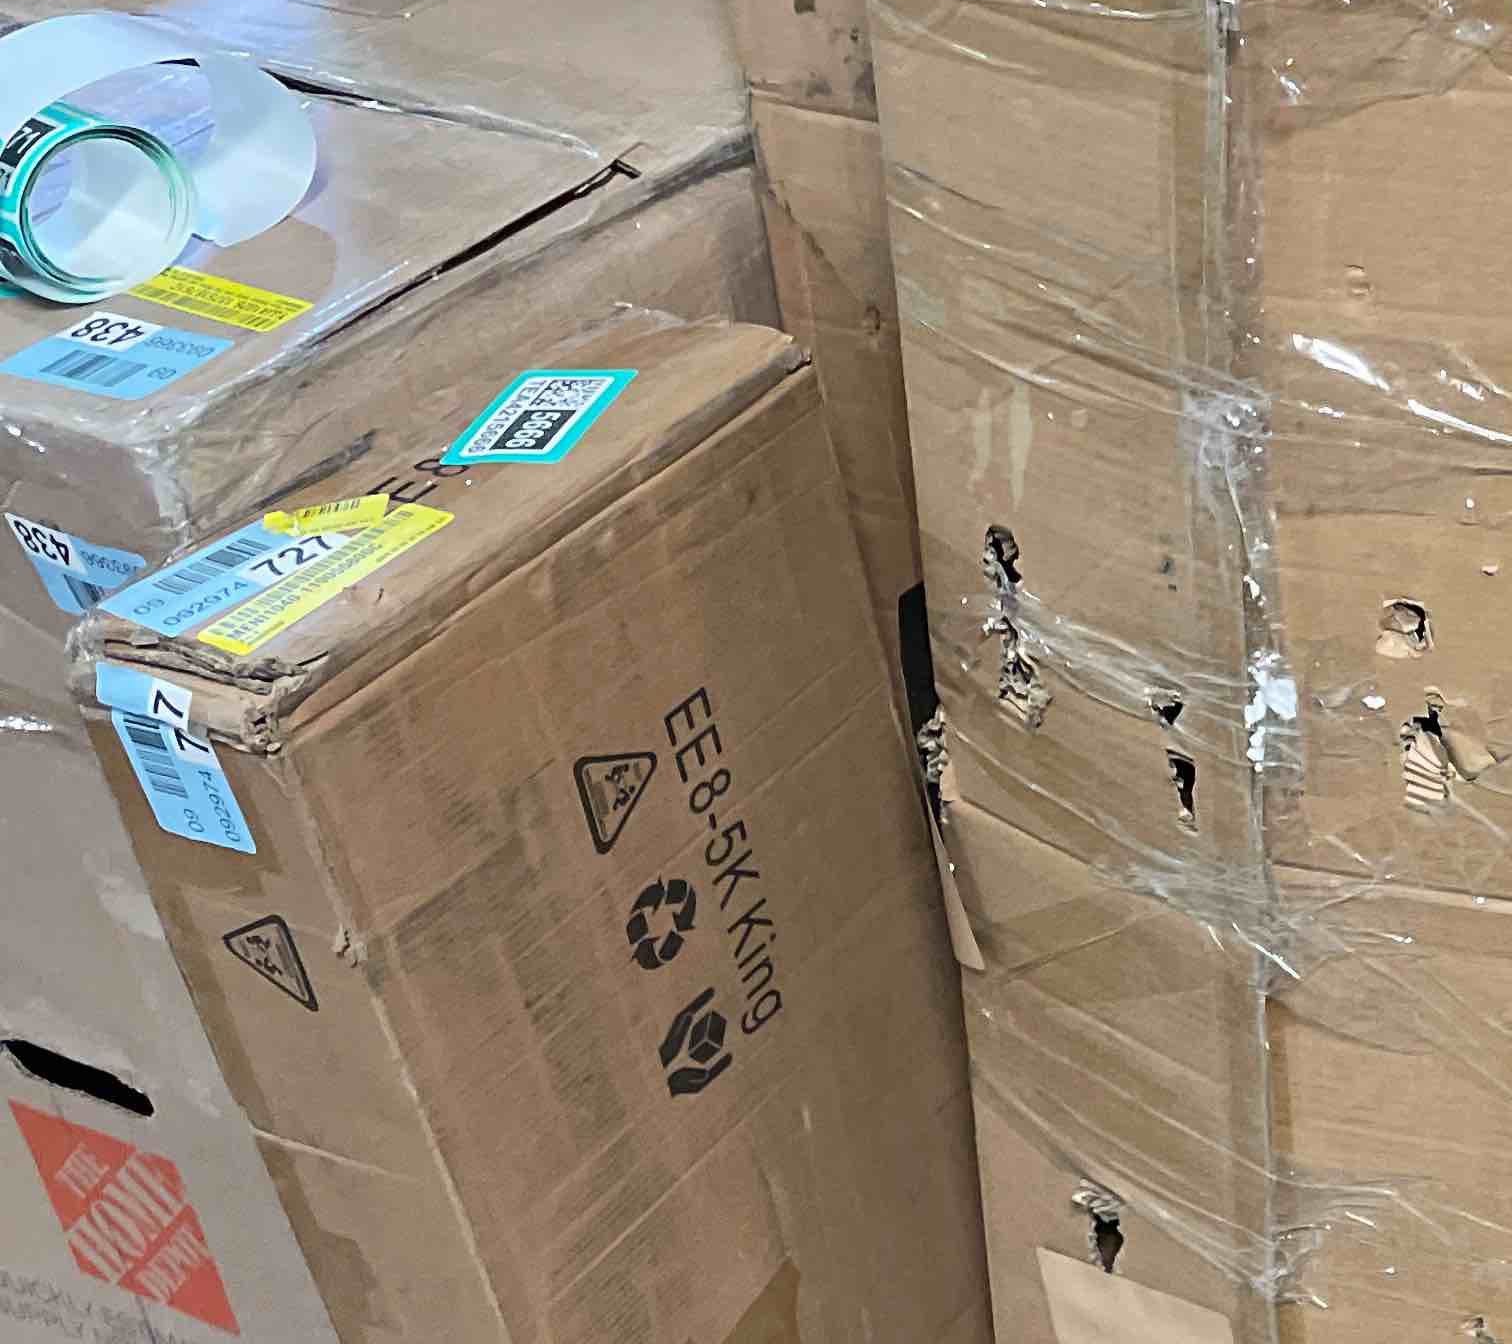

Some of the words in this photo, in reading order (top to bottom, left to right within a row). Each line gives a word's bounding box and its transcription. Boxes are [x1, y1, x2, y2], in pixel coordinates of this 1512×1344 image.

[71, 318, 144, 345] 438
[505, 410, 561, 449] 5666
[14, 520, 70, 565] 438
[250, 535, 334, 576] 727
[183, 808, 205, 833] 09
[199, 770, 241, 843] 092974
[664, 687, 760, 910] EE8-5K
[727, 899, 783, 1035] King
